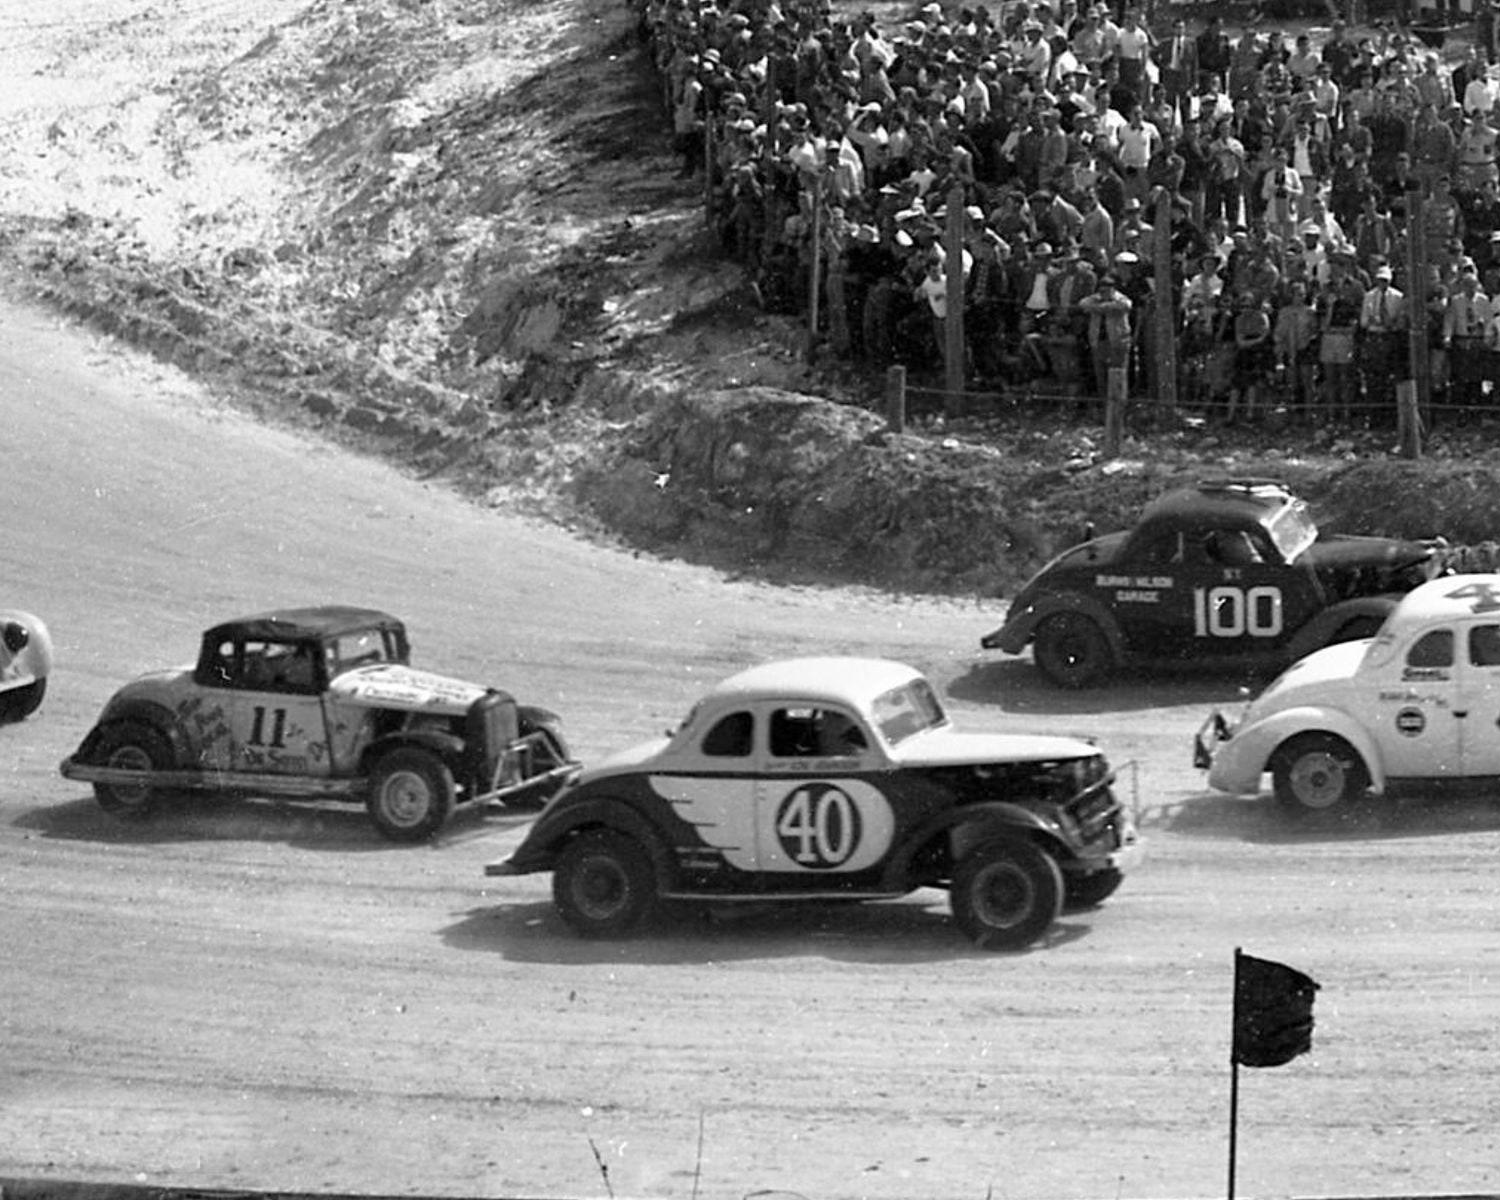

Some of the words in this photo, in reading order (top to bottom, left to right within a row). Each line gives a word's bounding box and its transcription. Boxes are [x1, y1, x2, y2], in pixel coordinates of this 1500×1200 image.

[1193, 585, 1284, 637] 100
[247, 706, 287, 749] 11
[779, 790, 853, 863] 40
